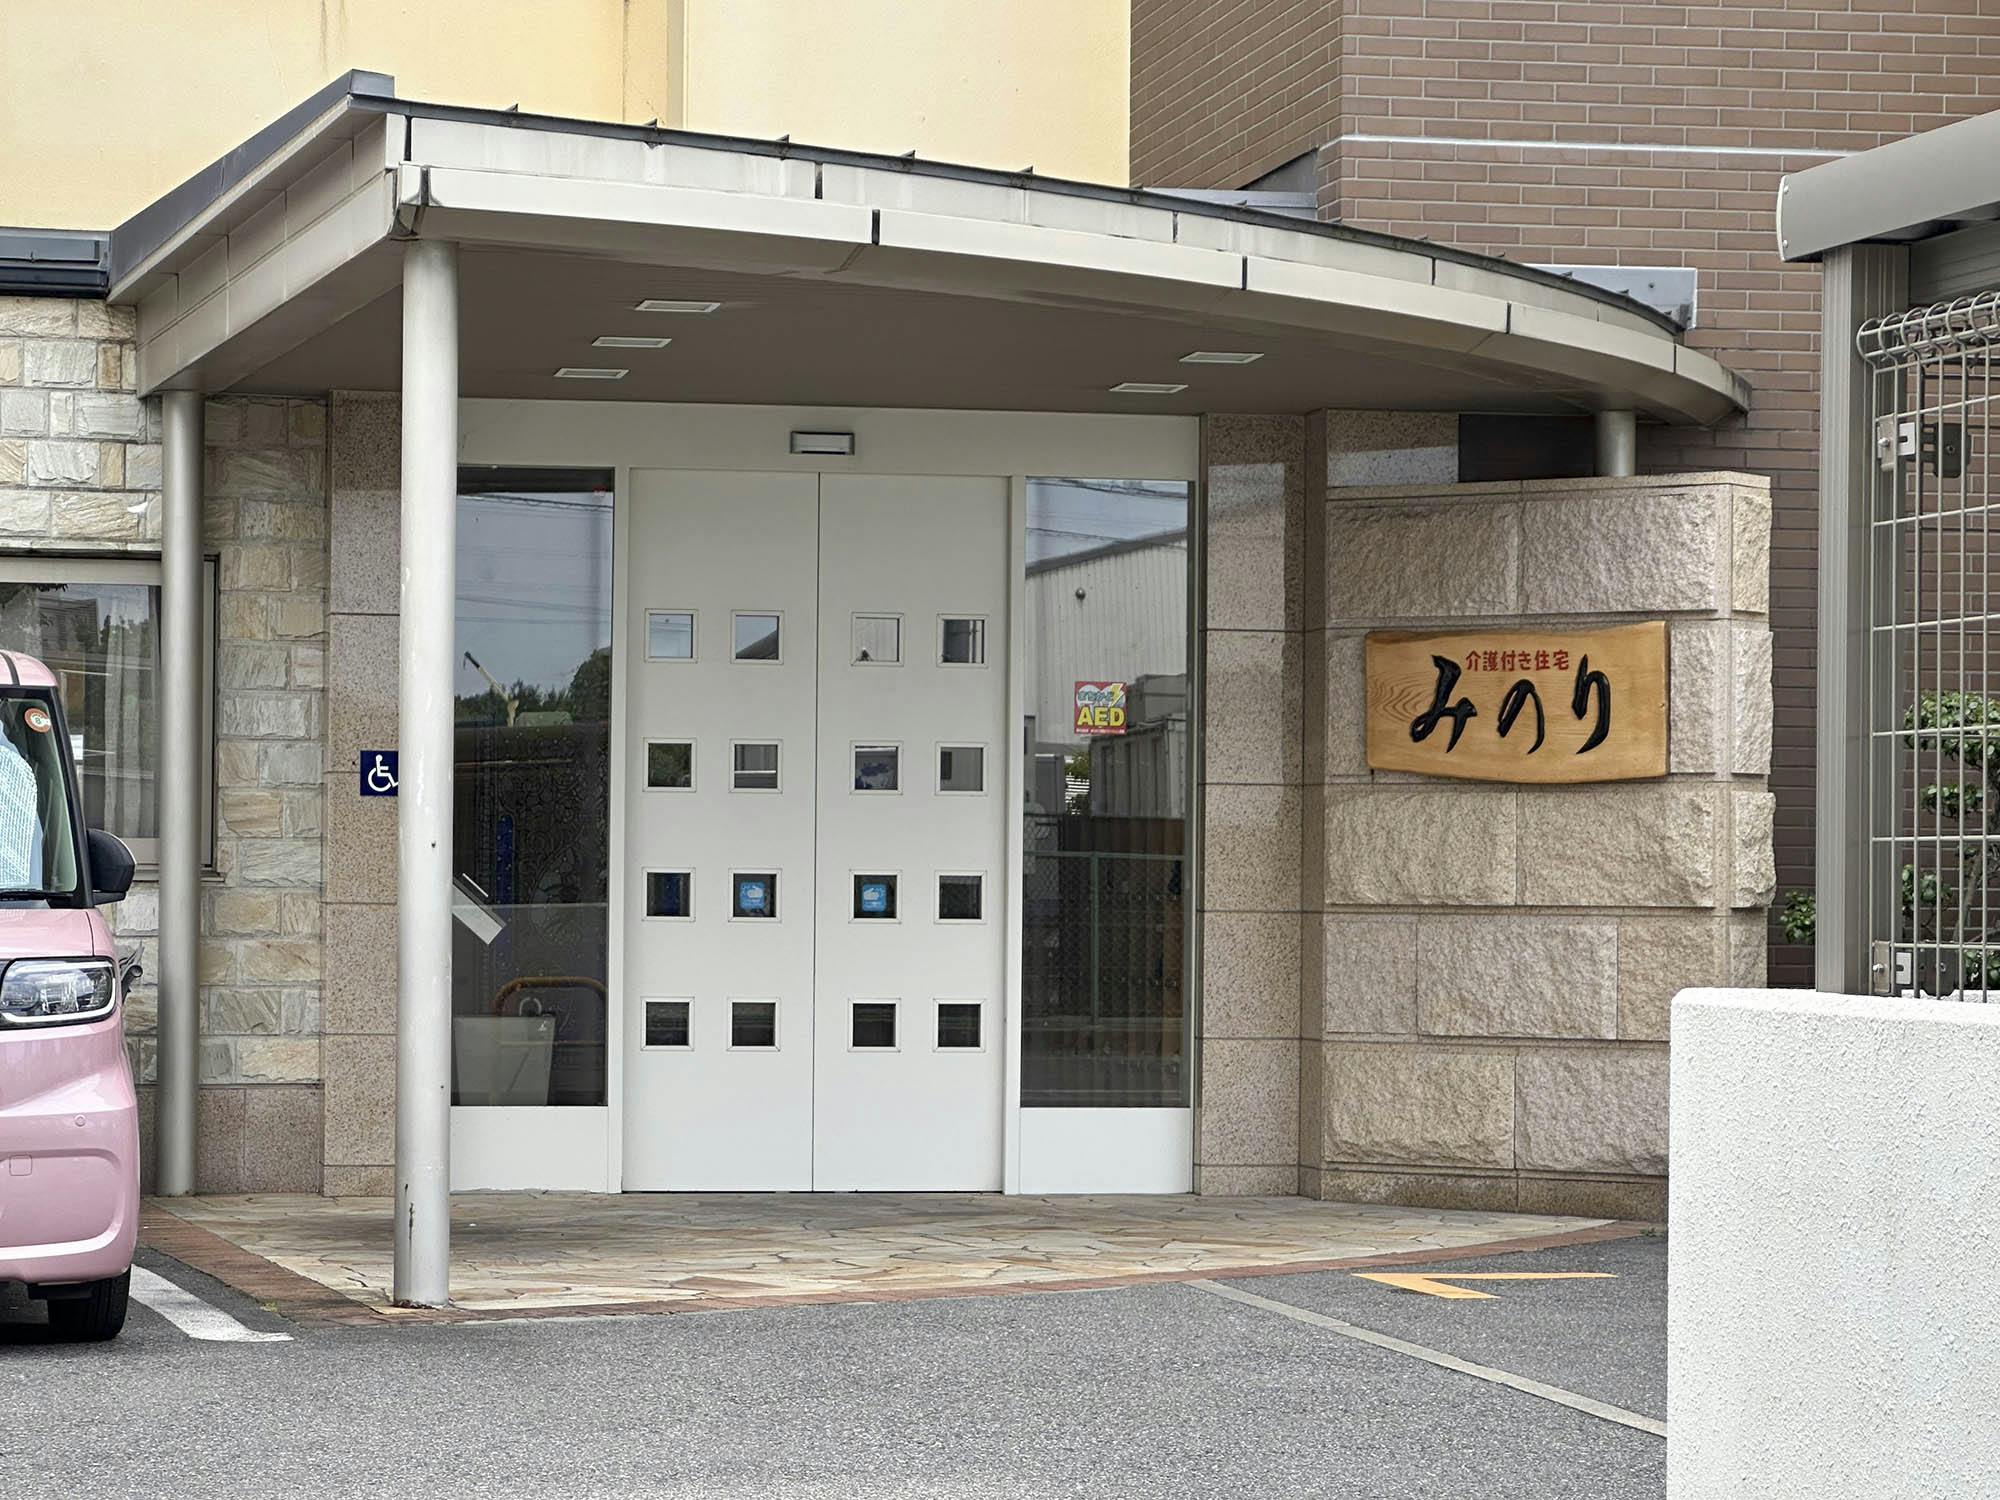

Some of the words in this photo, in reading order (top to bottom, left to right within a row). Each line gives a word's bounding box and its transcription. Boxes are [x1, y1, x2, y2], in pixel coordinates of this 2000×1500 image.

[1465, 649, 1569, 672] 介護付き住宅
[1409, 653, 1611, 755] みのり
[1077, 706, 1125, 726] AED
